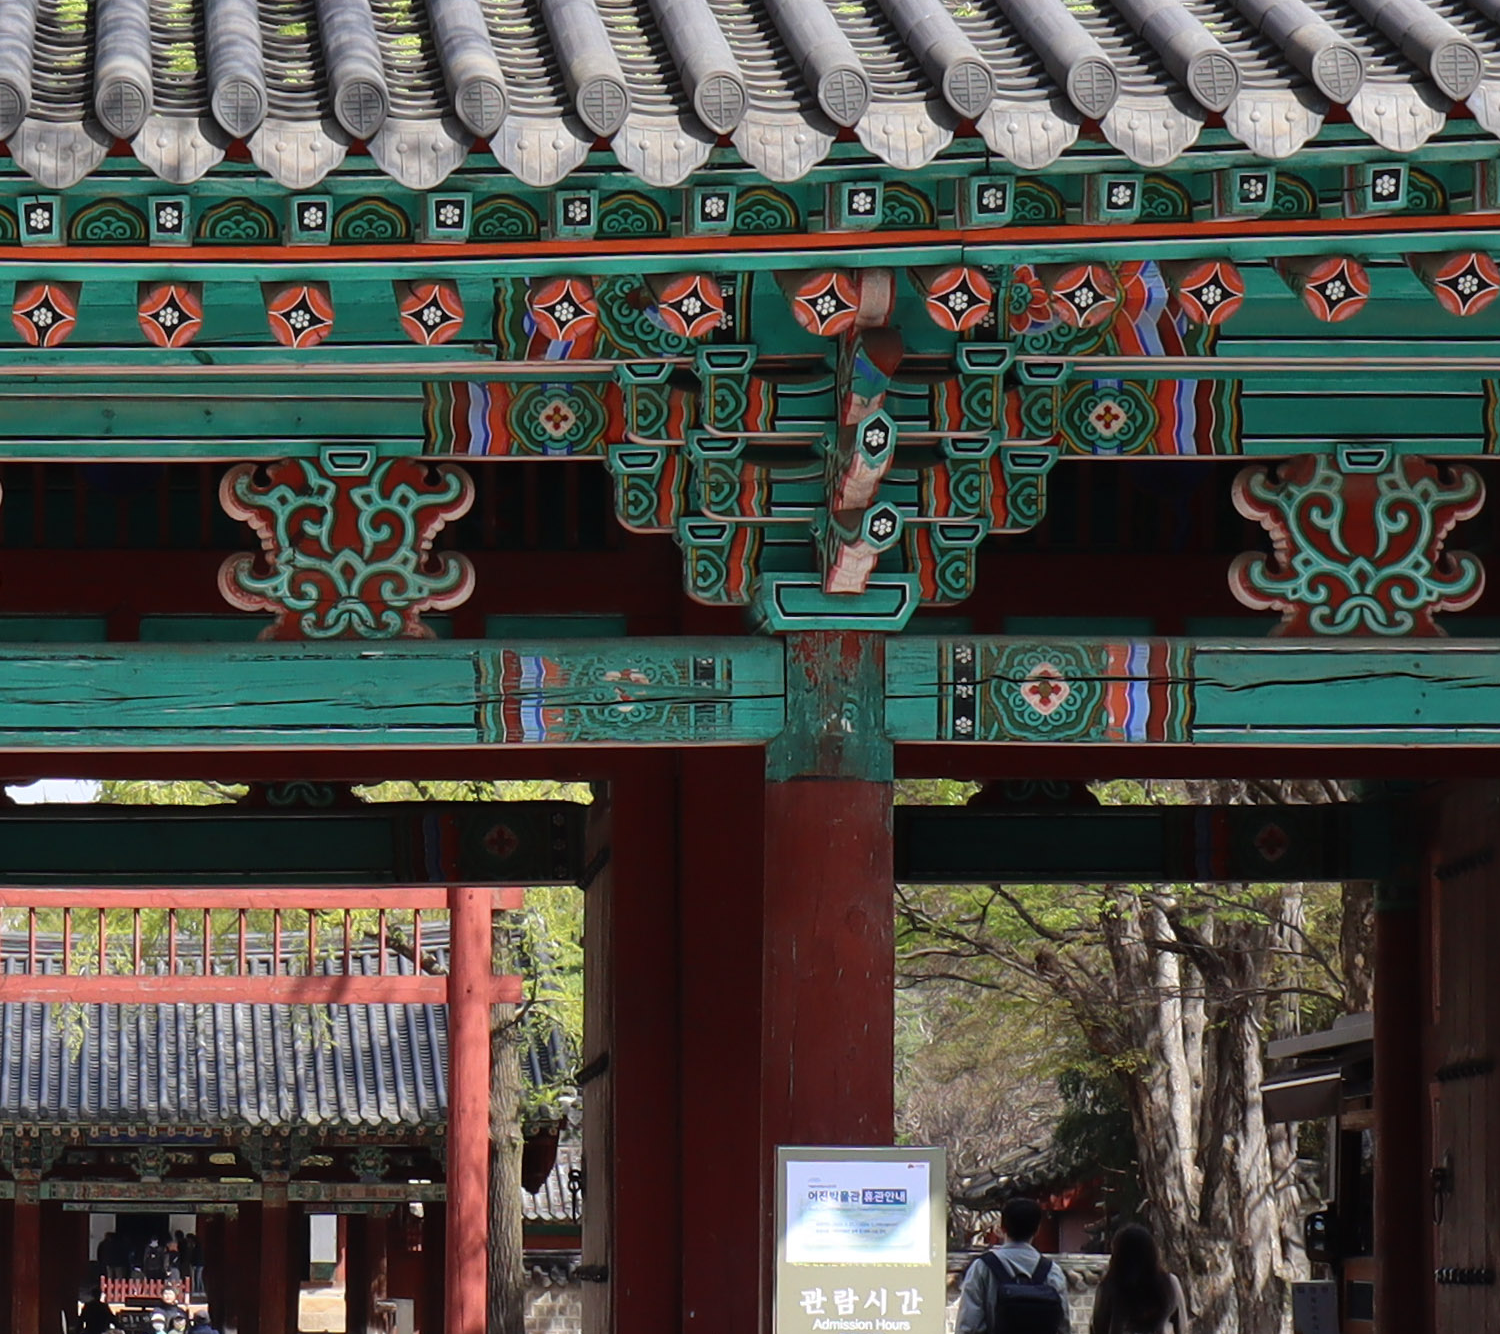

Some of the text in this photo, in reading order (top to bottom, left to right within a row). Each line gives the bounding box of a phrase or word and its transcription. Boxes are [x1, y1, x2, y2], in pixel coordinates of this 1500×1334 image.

[800, 1288, 923, 1316] 관람시간
[812, 1318, 911, 1331] Admission Hours
